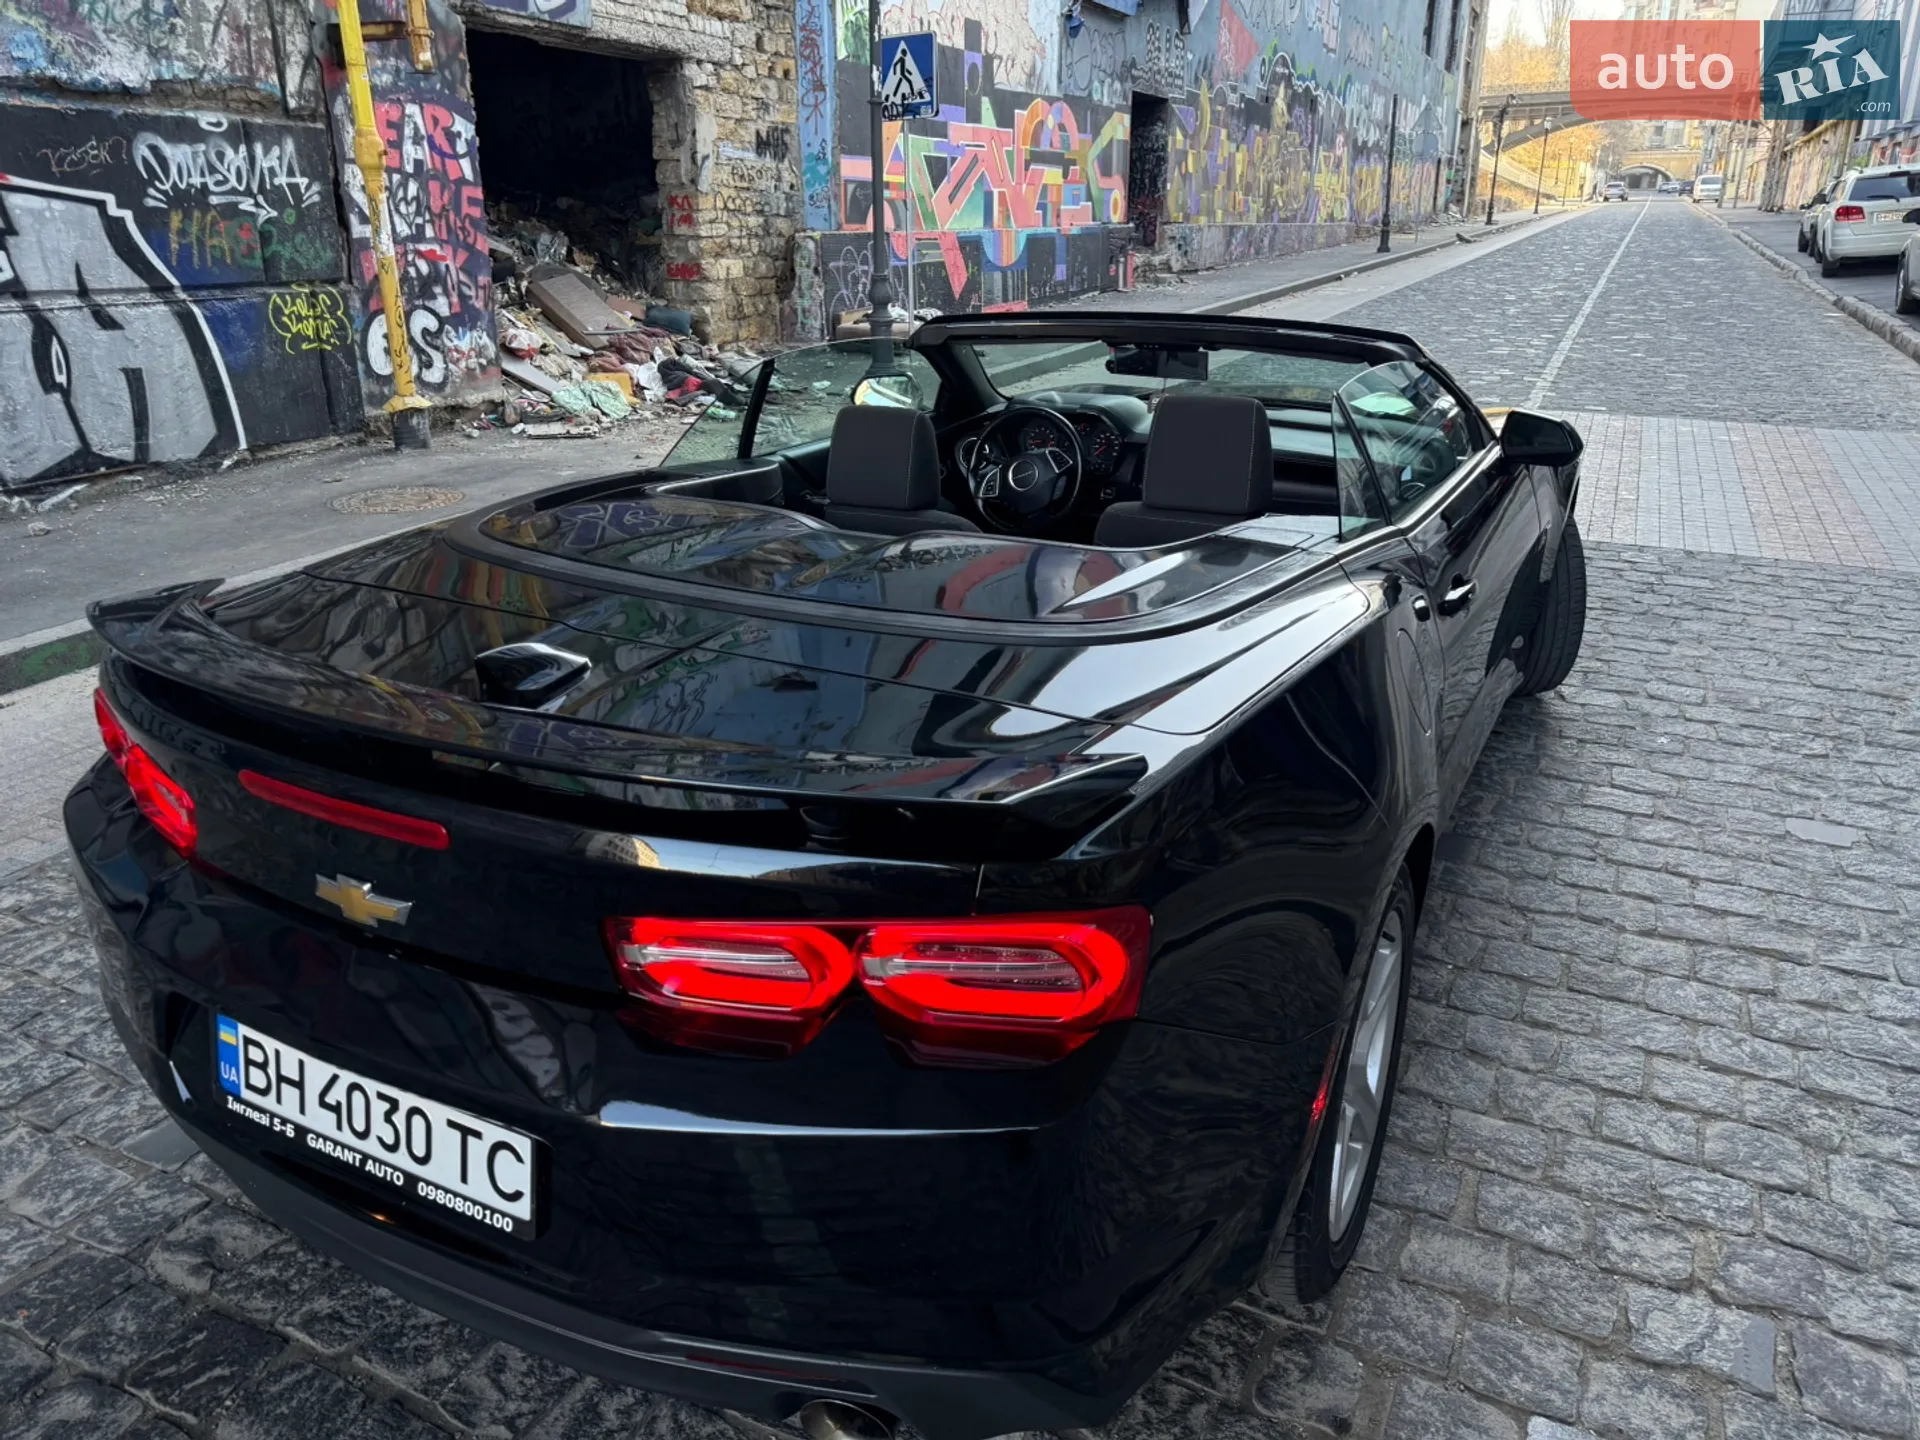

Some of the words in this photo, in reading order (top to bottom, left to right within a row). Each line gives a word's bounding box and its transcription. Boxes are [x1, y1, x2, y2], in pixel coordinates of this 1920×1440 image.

[221, 1061, 239, 1085] UA
[242, 1034, 306, 1116] BH
[318, 1072, 432, 1166] 4030
[446, 1117, 526, 1203] TC
[226, 1095, 270, 1127] Інглезі
[306, 1134, 363, 1169] GARANT
[365, 1161, 404, 1187] AUTO
[417, 1181, 514, 1233] 0980800100
